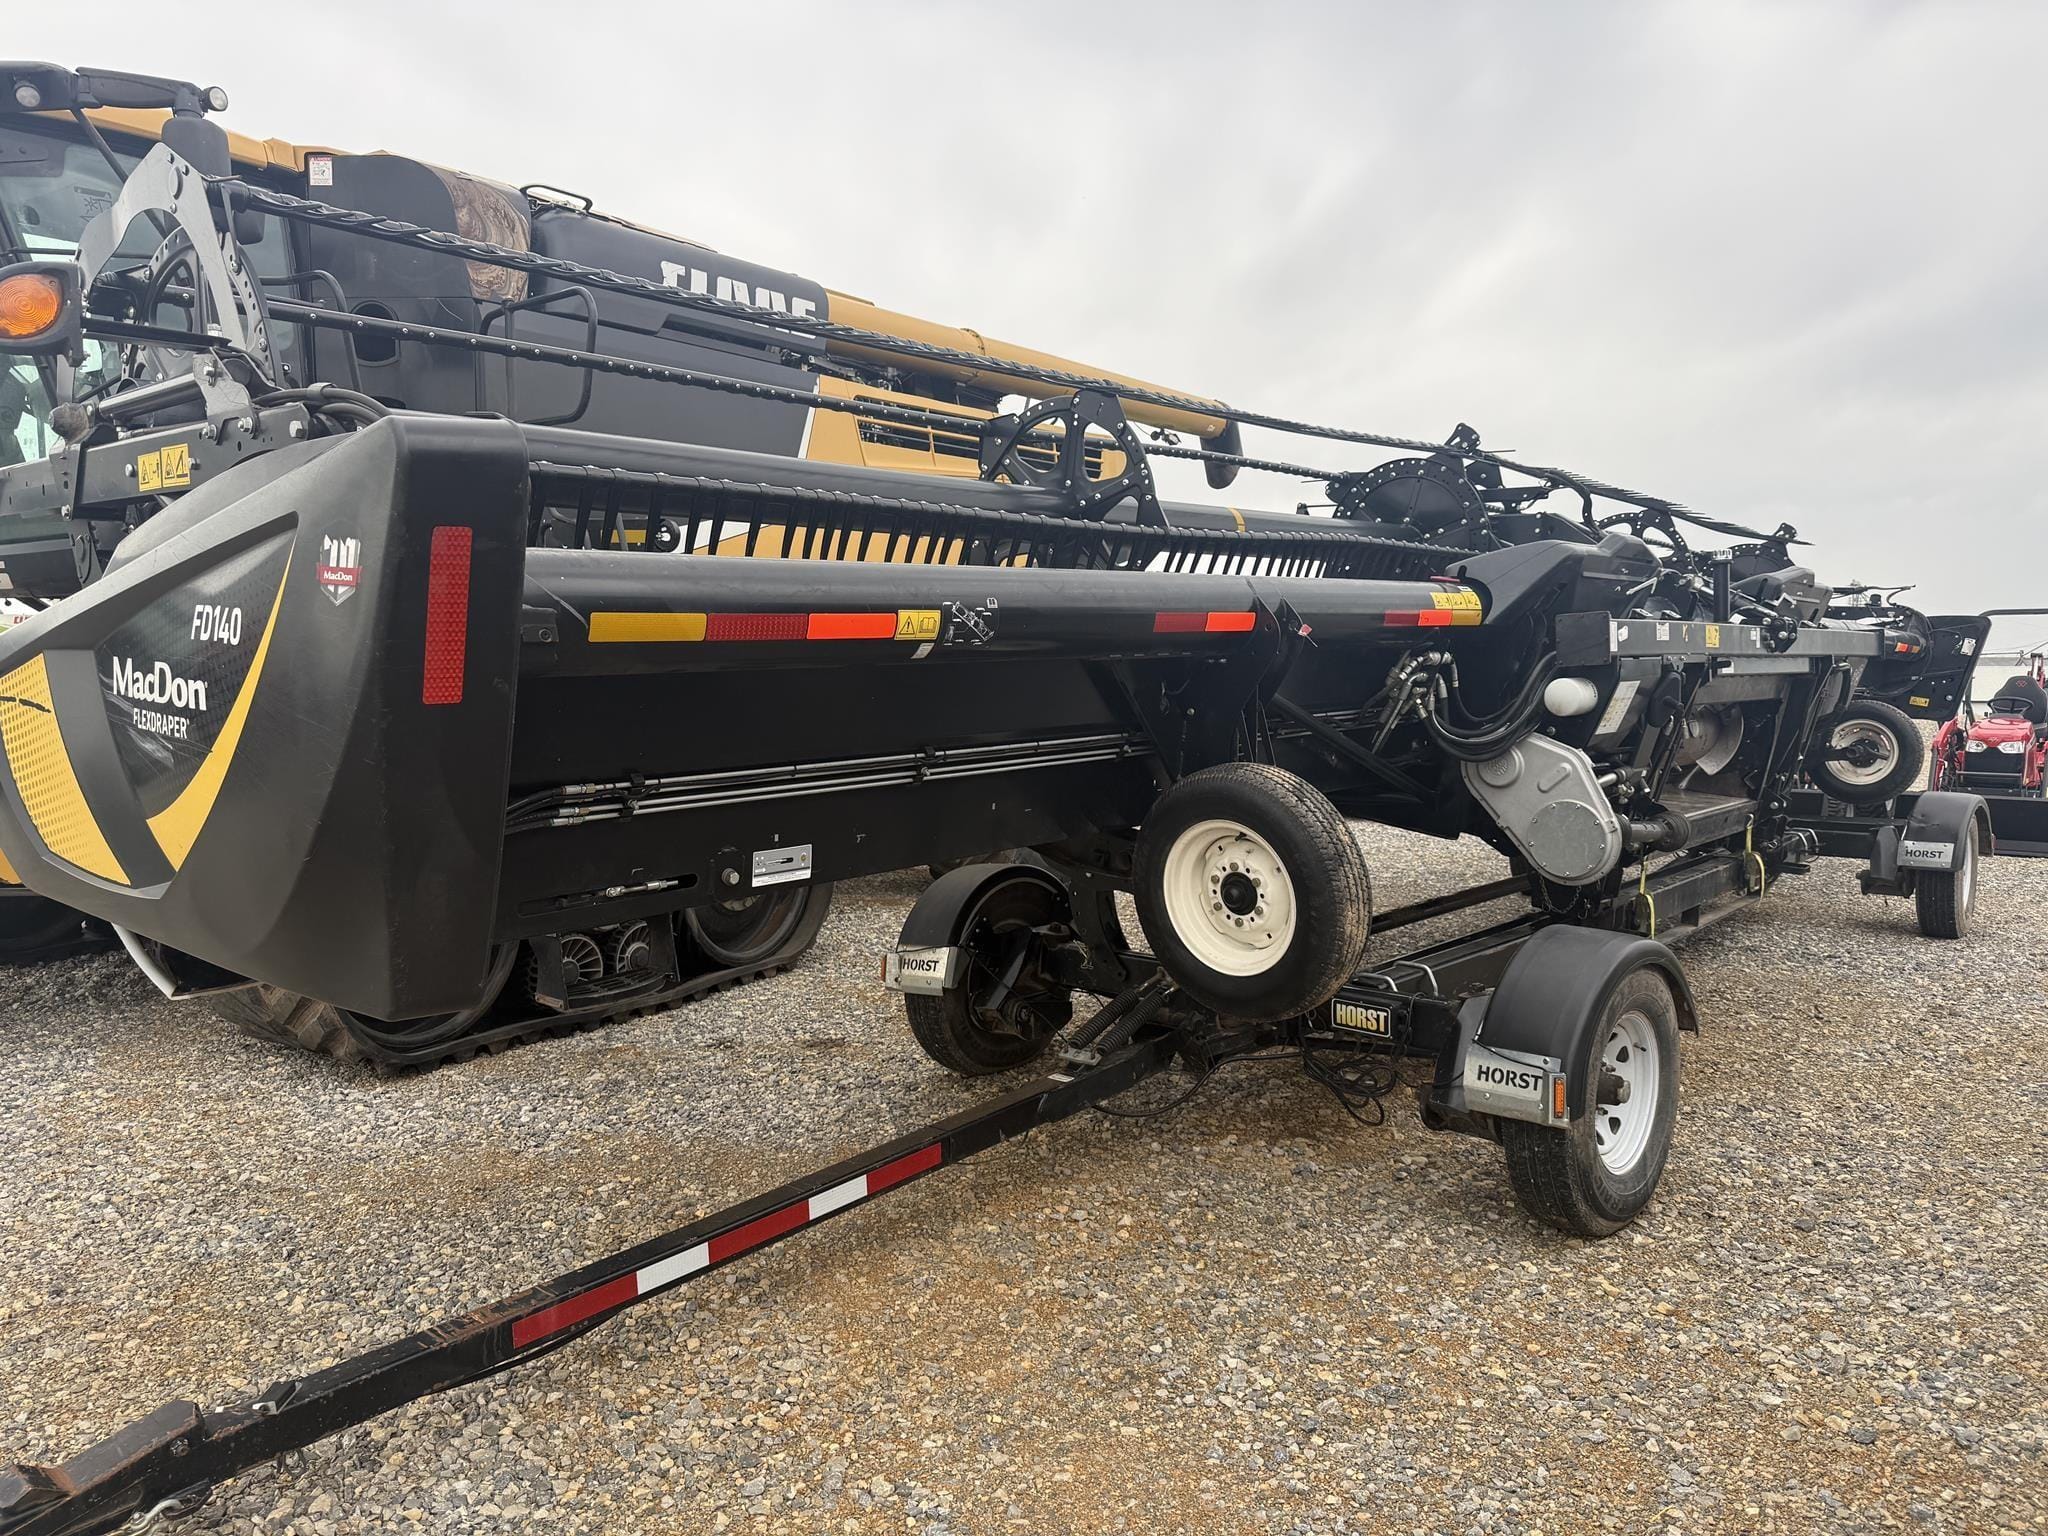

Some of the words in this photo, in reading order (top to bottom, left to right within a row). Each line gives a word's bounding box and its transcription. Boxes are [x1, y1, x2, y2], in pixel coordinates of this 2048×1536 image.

[323, 570, 353, 581] MacDon
[191, 604, 242, 646] FD140
[1905, 849, 1944, 859] HORST
[903, 957, 939, 972] HORST
[1336, 1003, 1387, 1032] HORST
[1477, 1064, 1543, 1091] HORST
